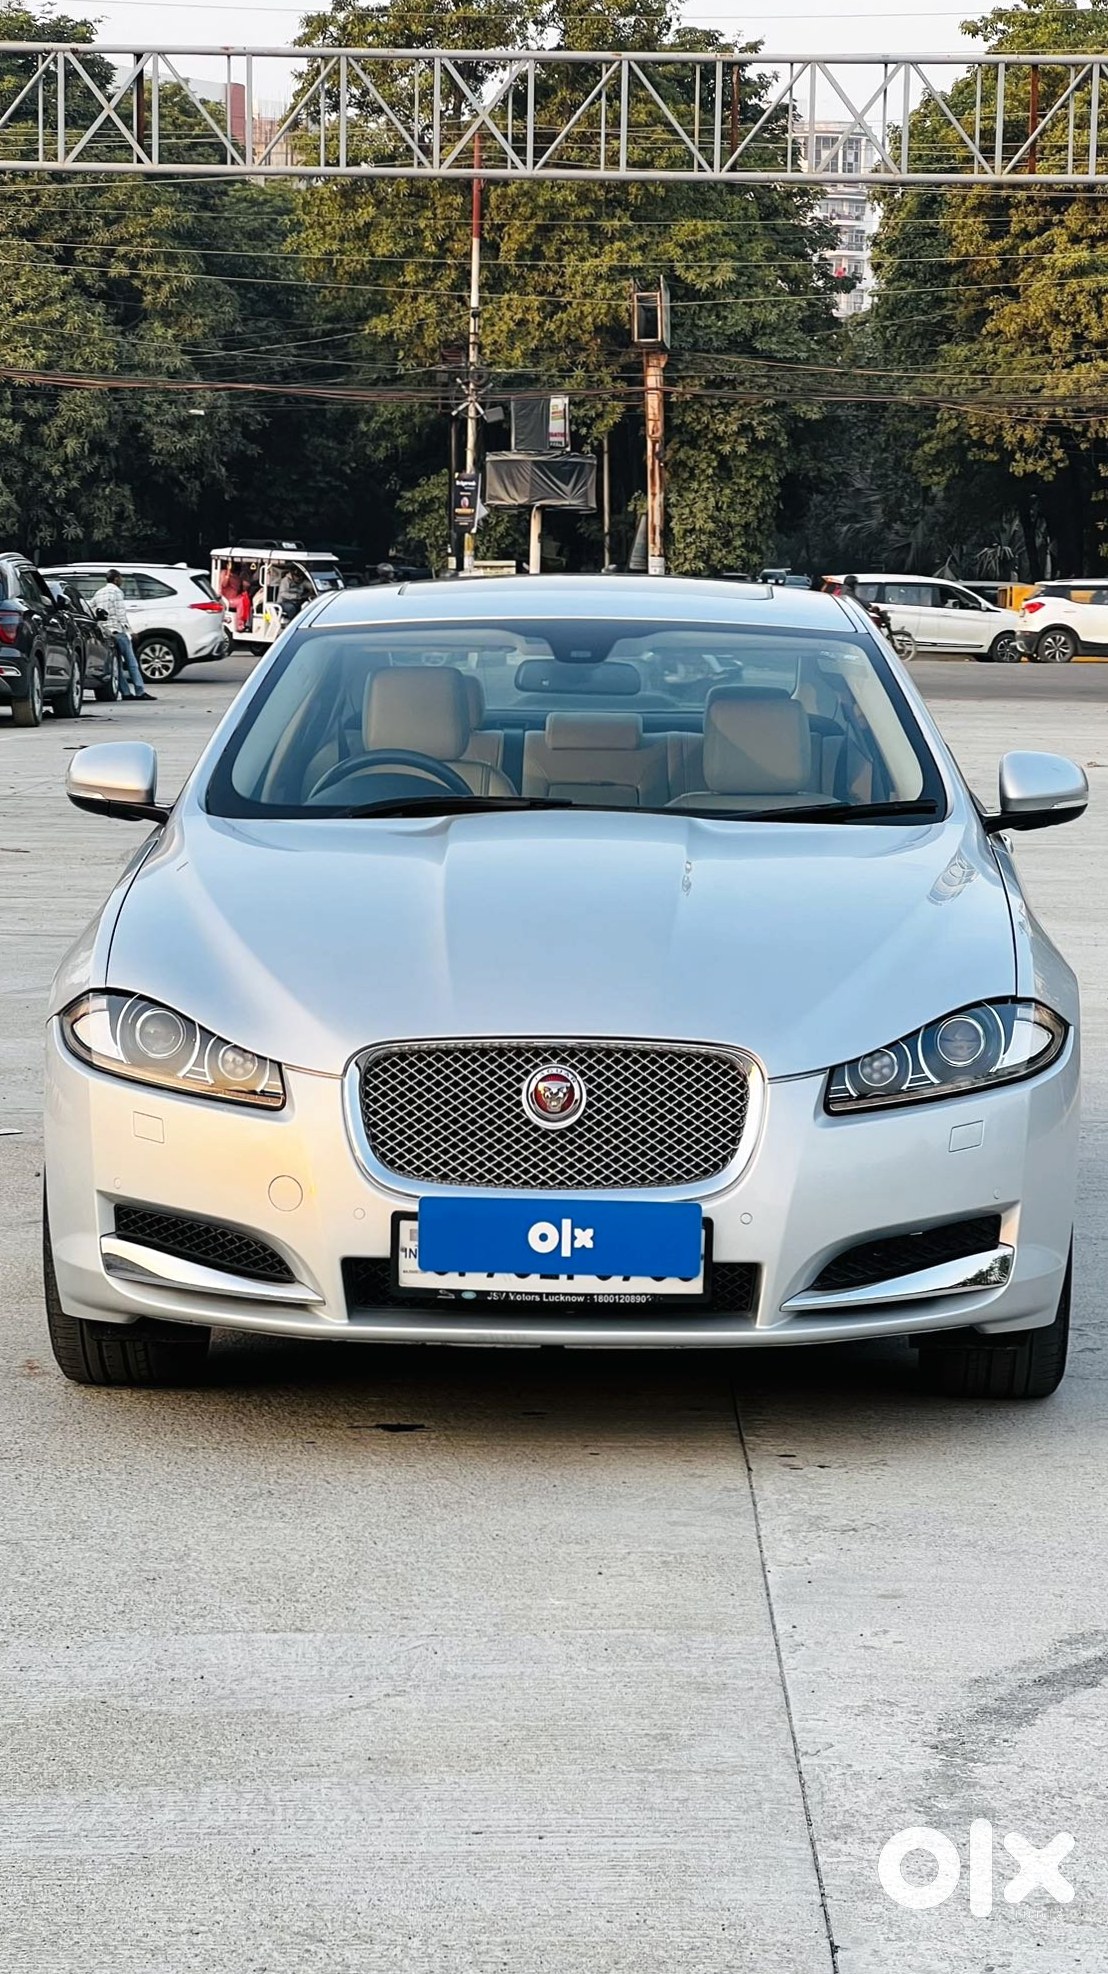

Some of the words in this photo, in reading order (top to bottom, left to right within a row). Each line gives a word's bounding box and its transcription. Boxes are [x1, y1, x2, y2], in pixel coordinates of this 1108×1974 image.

[404, 1247, 418, 1259] IN
[487, 1291, 506, 1301] JSV
[542, 1293, 586, 1302] Lucknow
